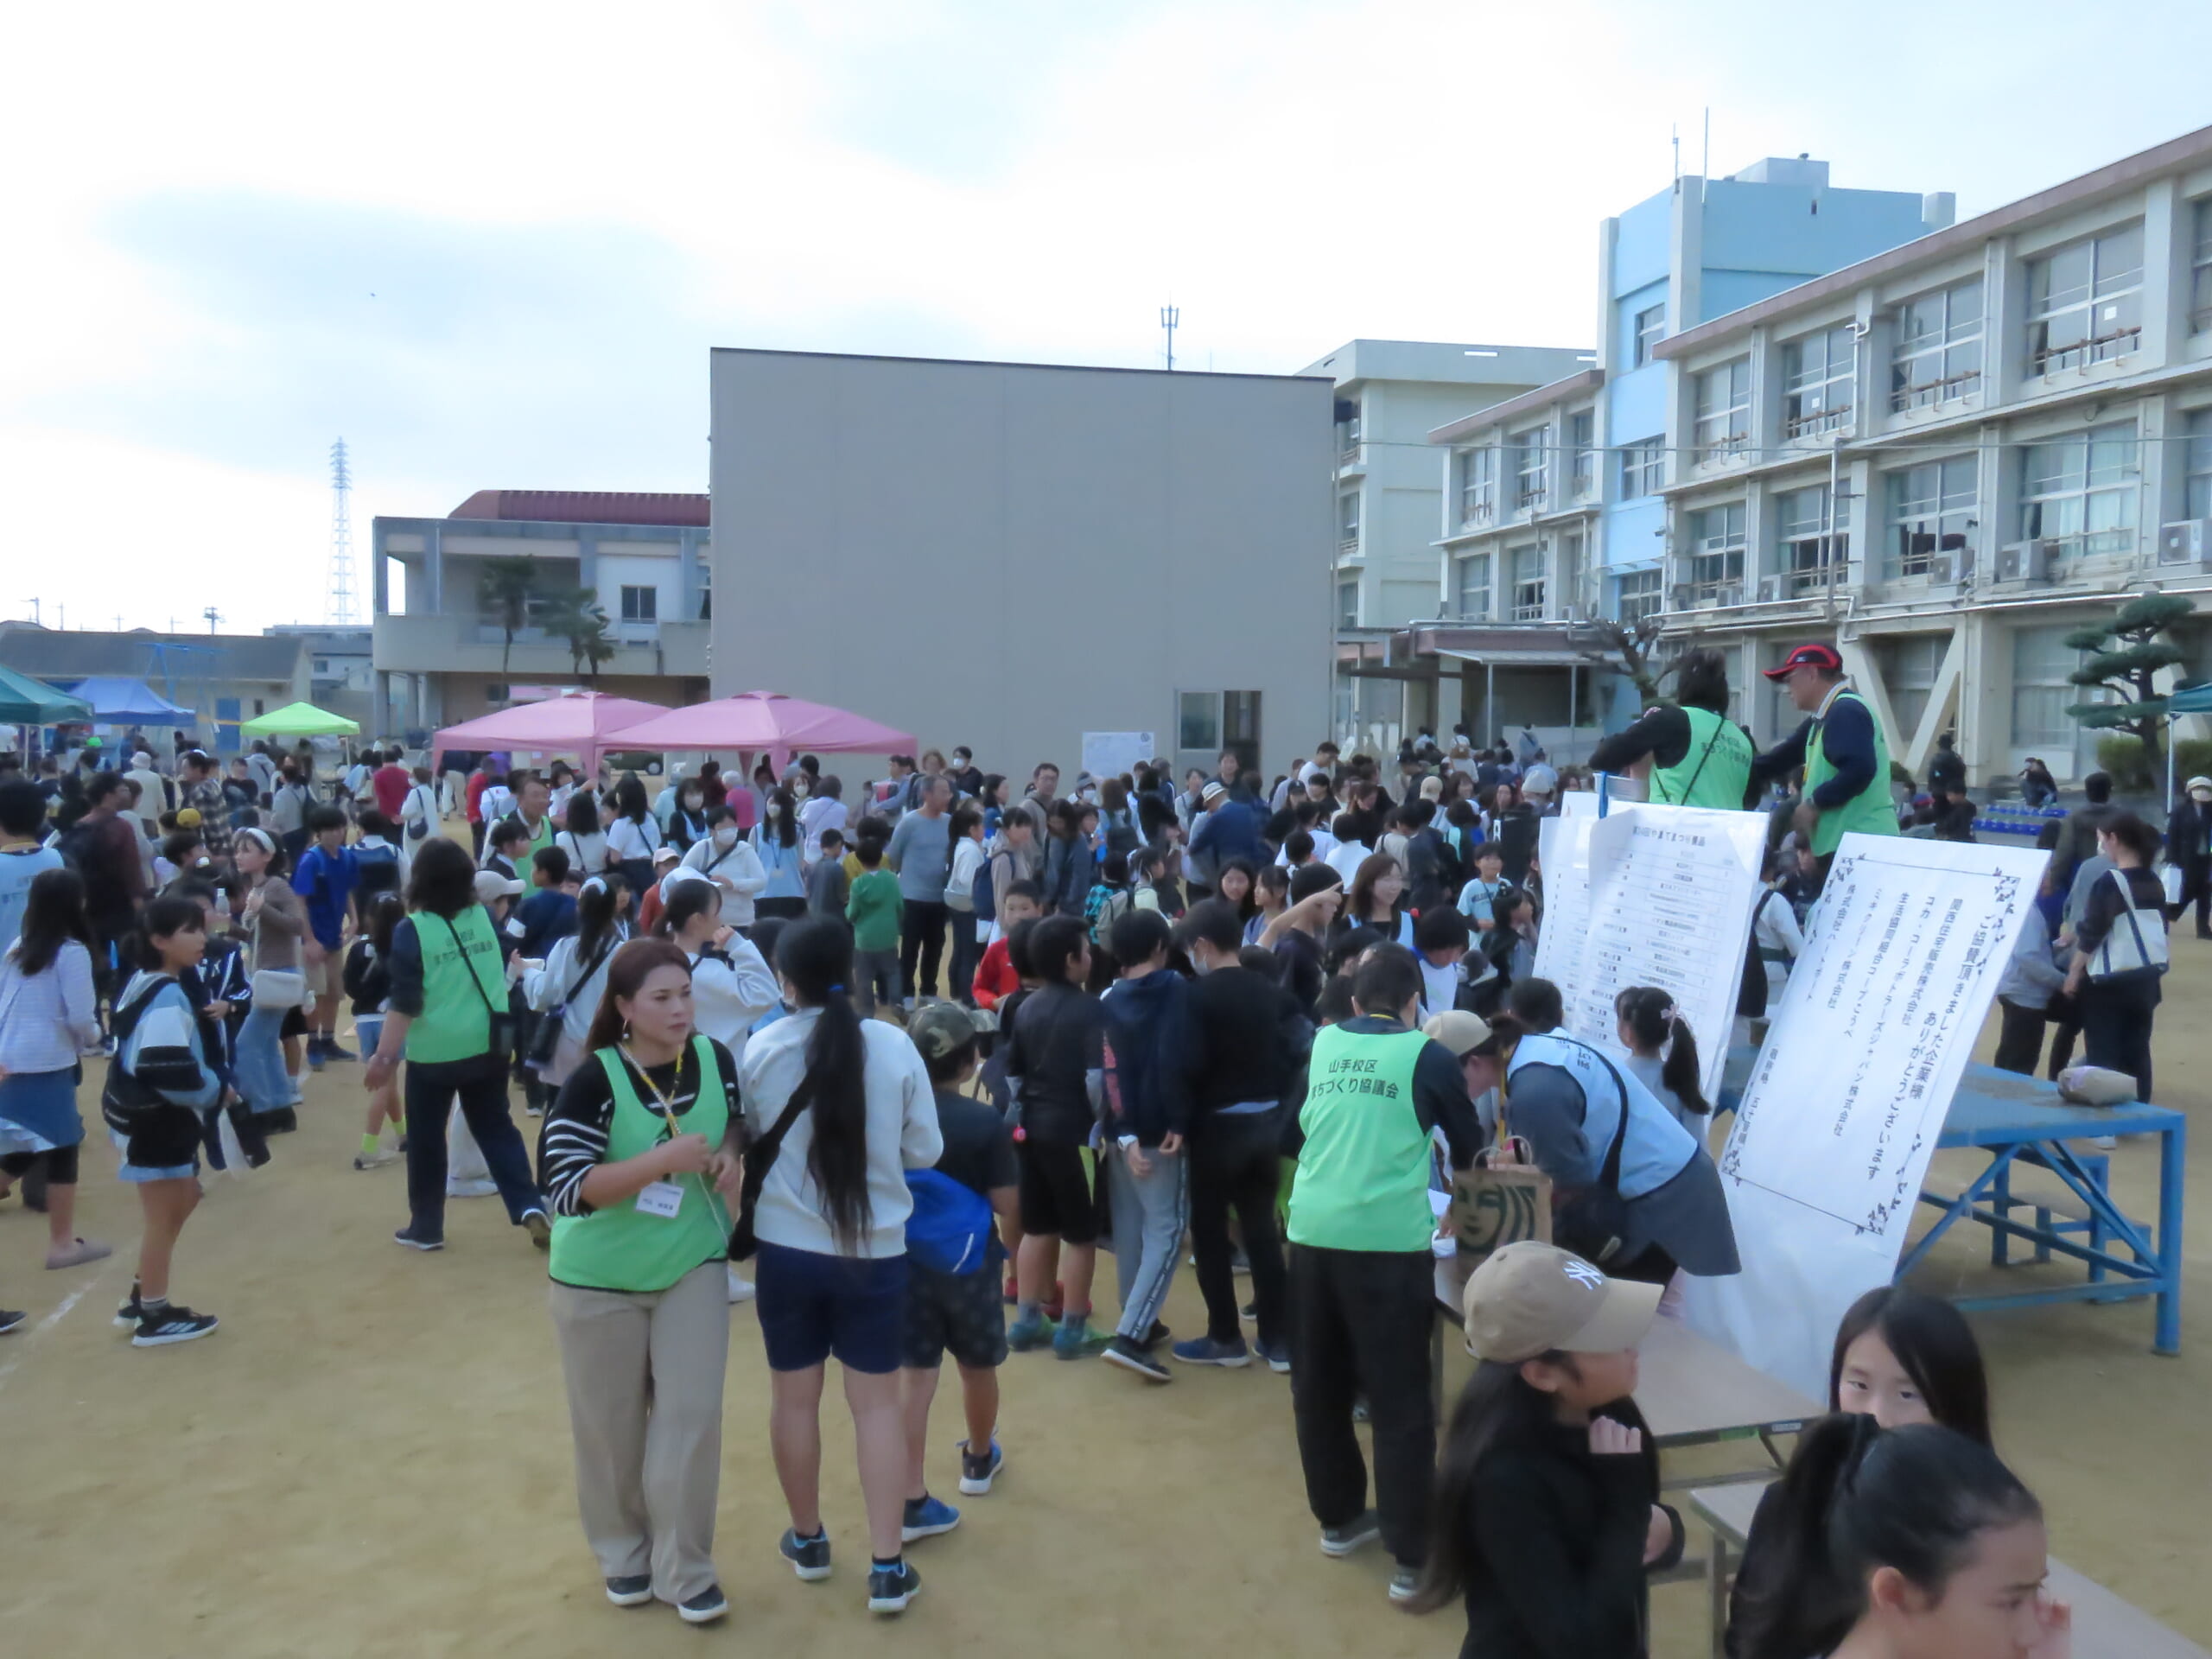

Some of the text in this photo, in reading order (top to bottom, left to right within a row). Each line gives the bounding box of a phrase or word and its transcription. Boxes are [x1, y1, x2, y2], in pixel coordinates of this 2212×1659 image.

[1328, 1058, 1378, 1074] 山手校区
[1867, 1011, 1937, 1180] ありがとうございます
